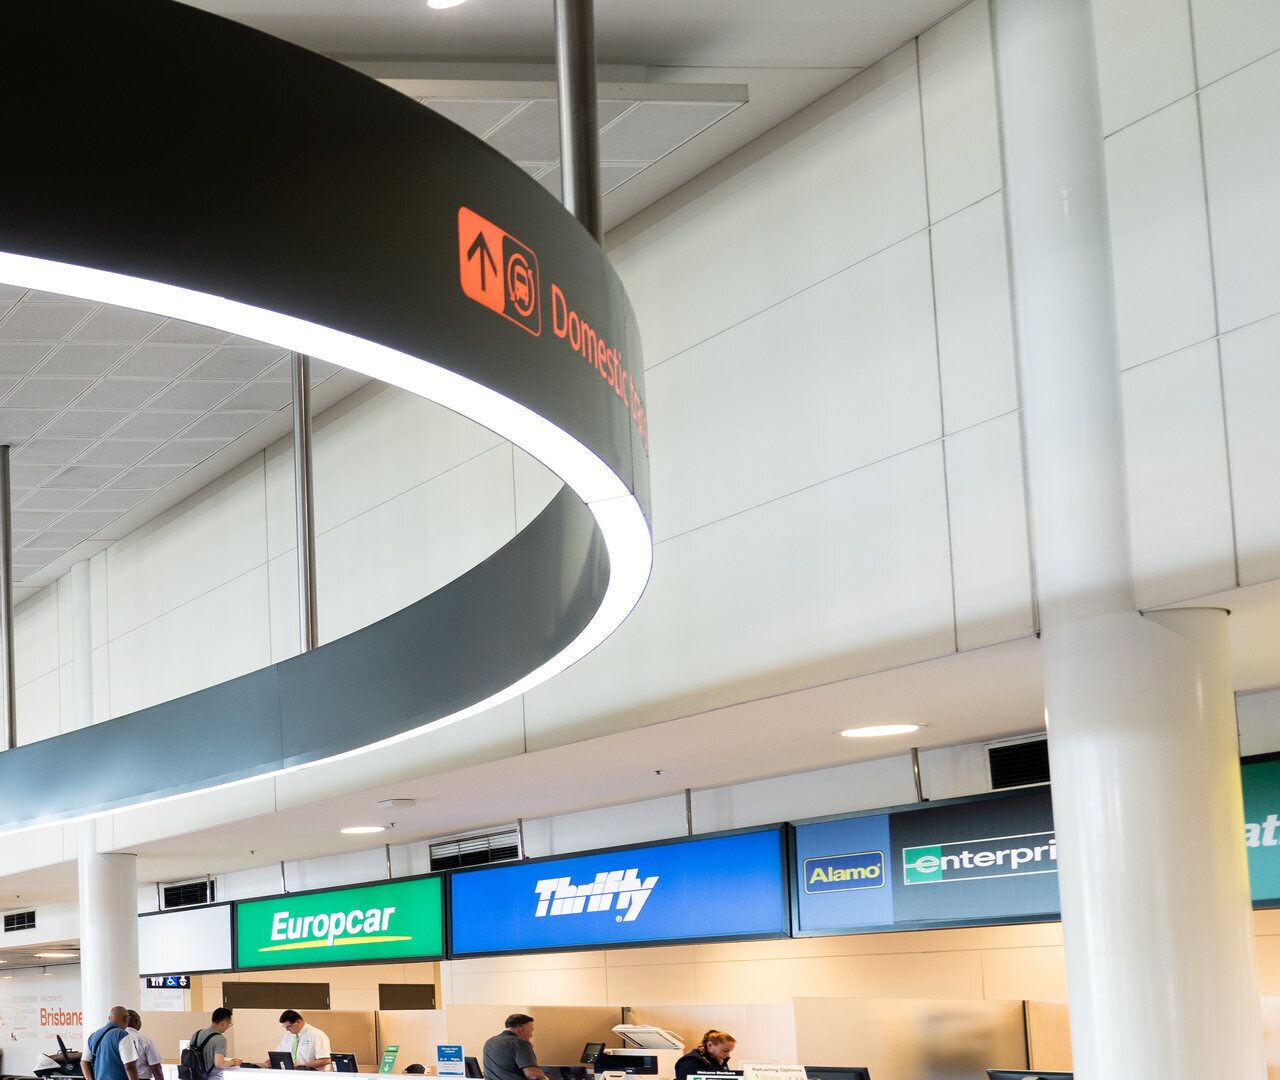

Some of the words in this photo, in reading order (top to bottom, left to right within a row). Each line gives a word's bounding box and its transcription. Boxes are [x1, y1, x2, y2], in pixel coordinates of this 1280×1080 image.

[551, 283, 629, 408] Domestic
[809, 864, 881, 885] Alamo
[905, 840, 1056, 873] enterpri
[534, 868, 660, 922] Thrifty
[270, 905, 397, 947] Europcar
